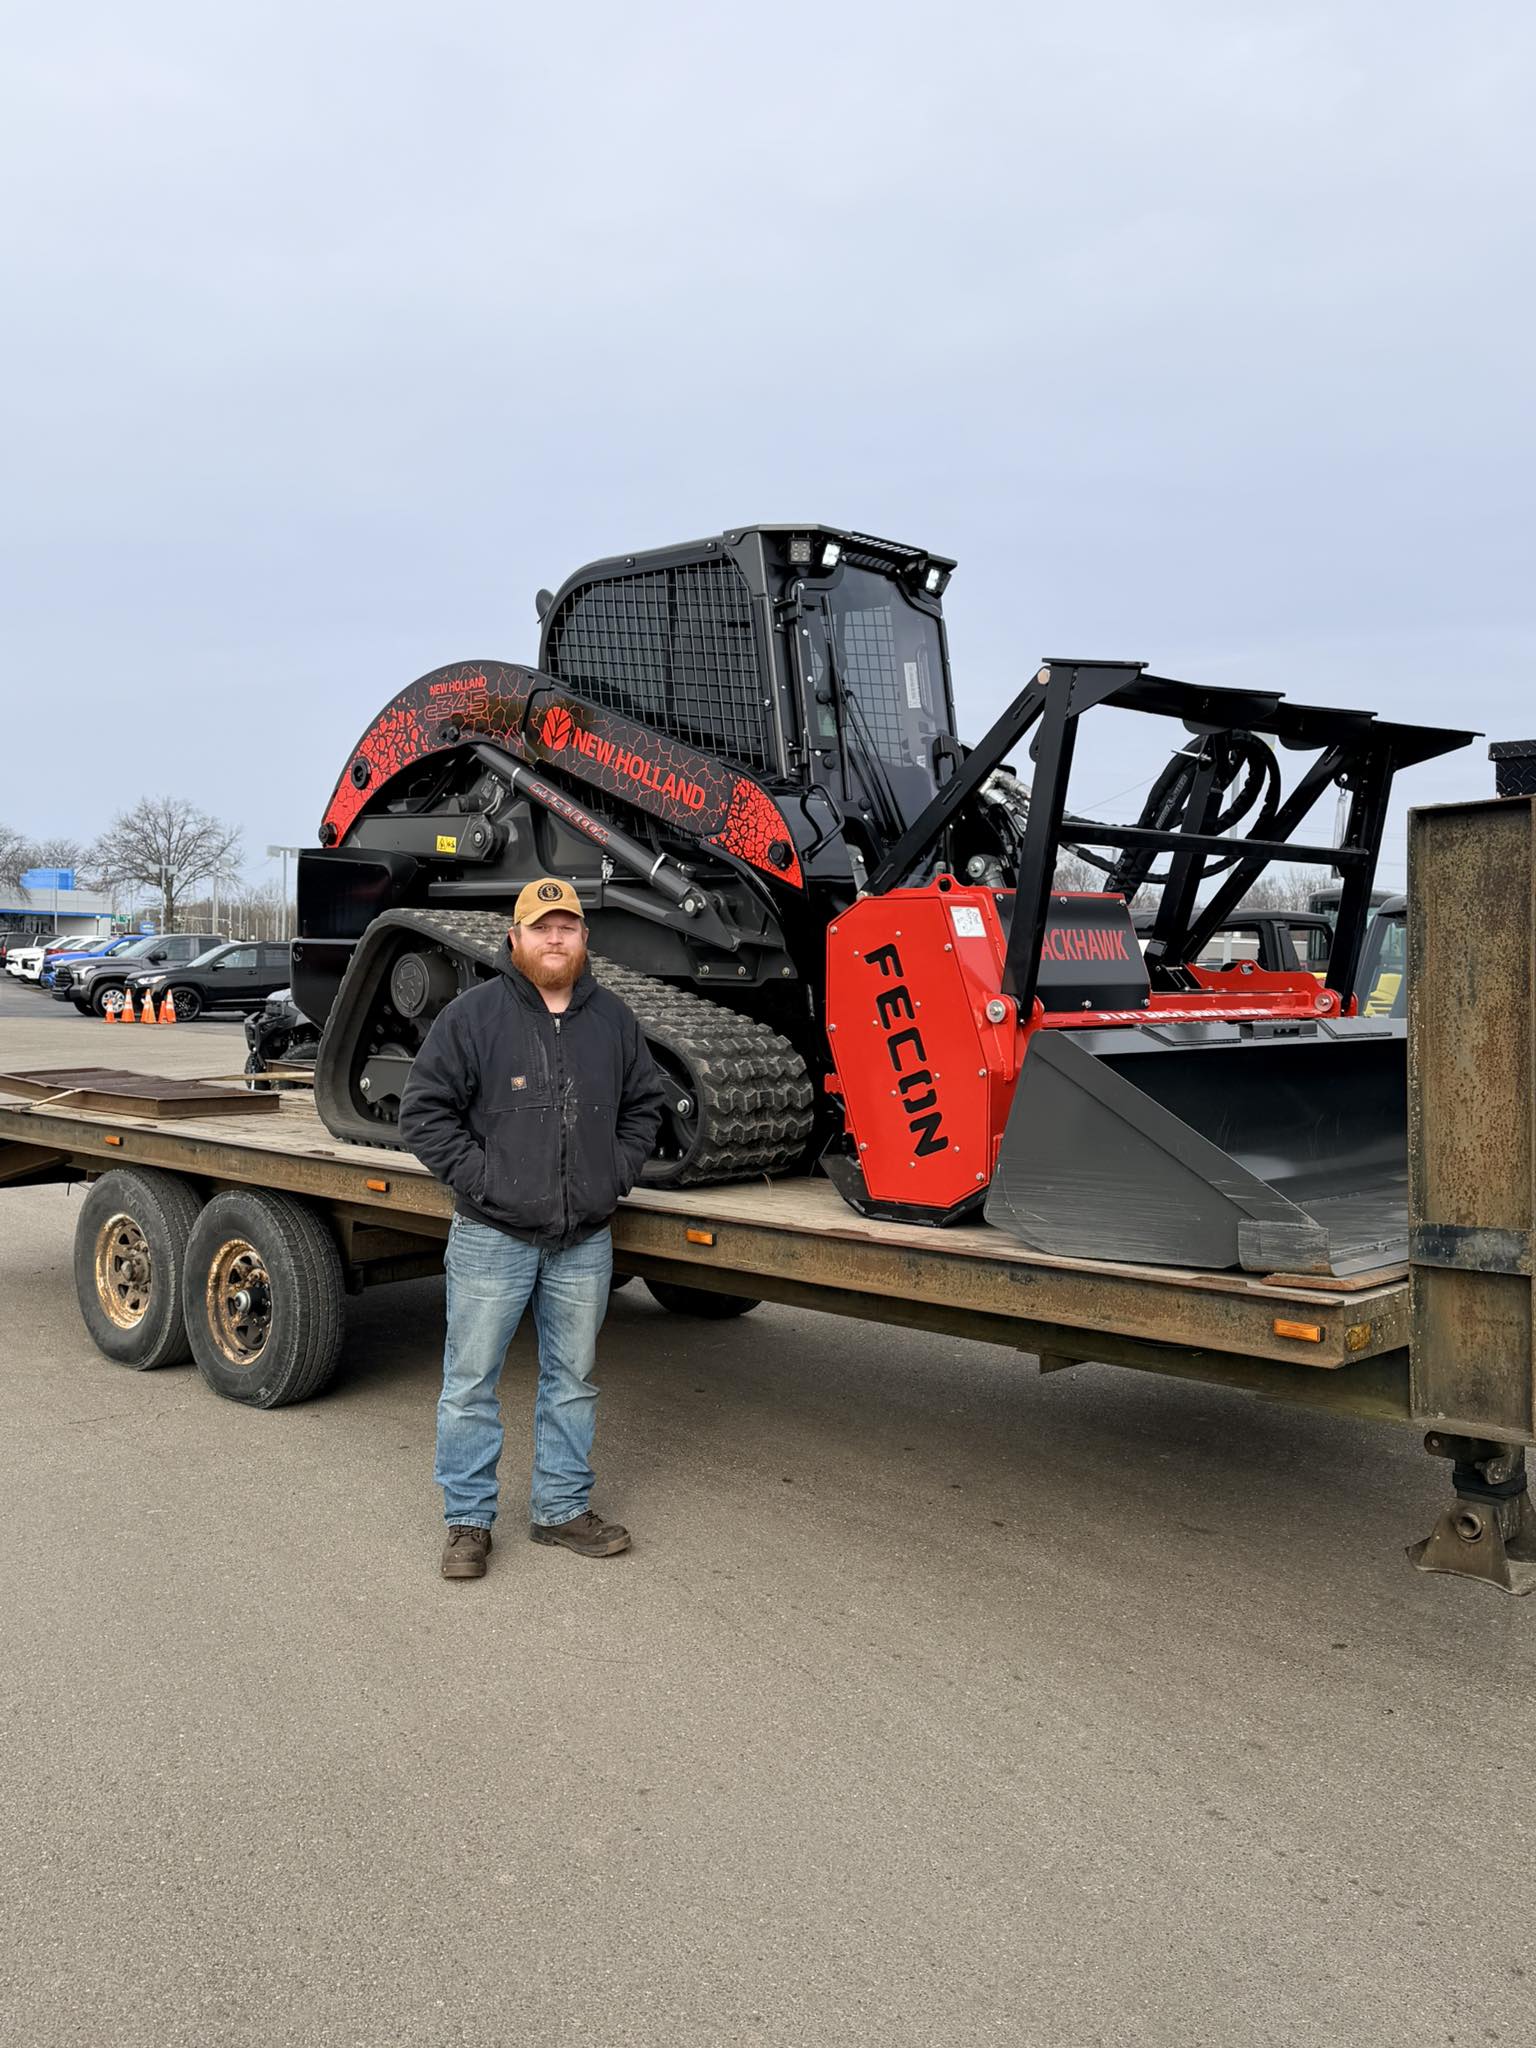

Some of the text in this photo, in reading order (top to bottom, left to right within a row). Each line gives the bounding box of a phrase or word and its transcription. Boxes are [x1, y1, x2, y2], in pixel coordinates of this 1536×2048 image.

[429, 676, 486, 696] NEW HOLLAND
[572, 727, 706, 810] NEW HOLLAND
[1040, 928, 1130, 961] ACKHAWK
[864, 943, 948, 1157] FECON
